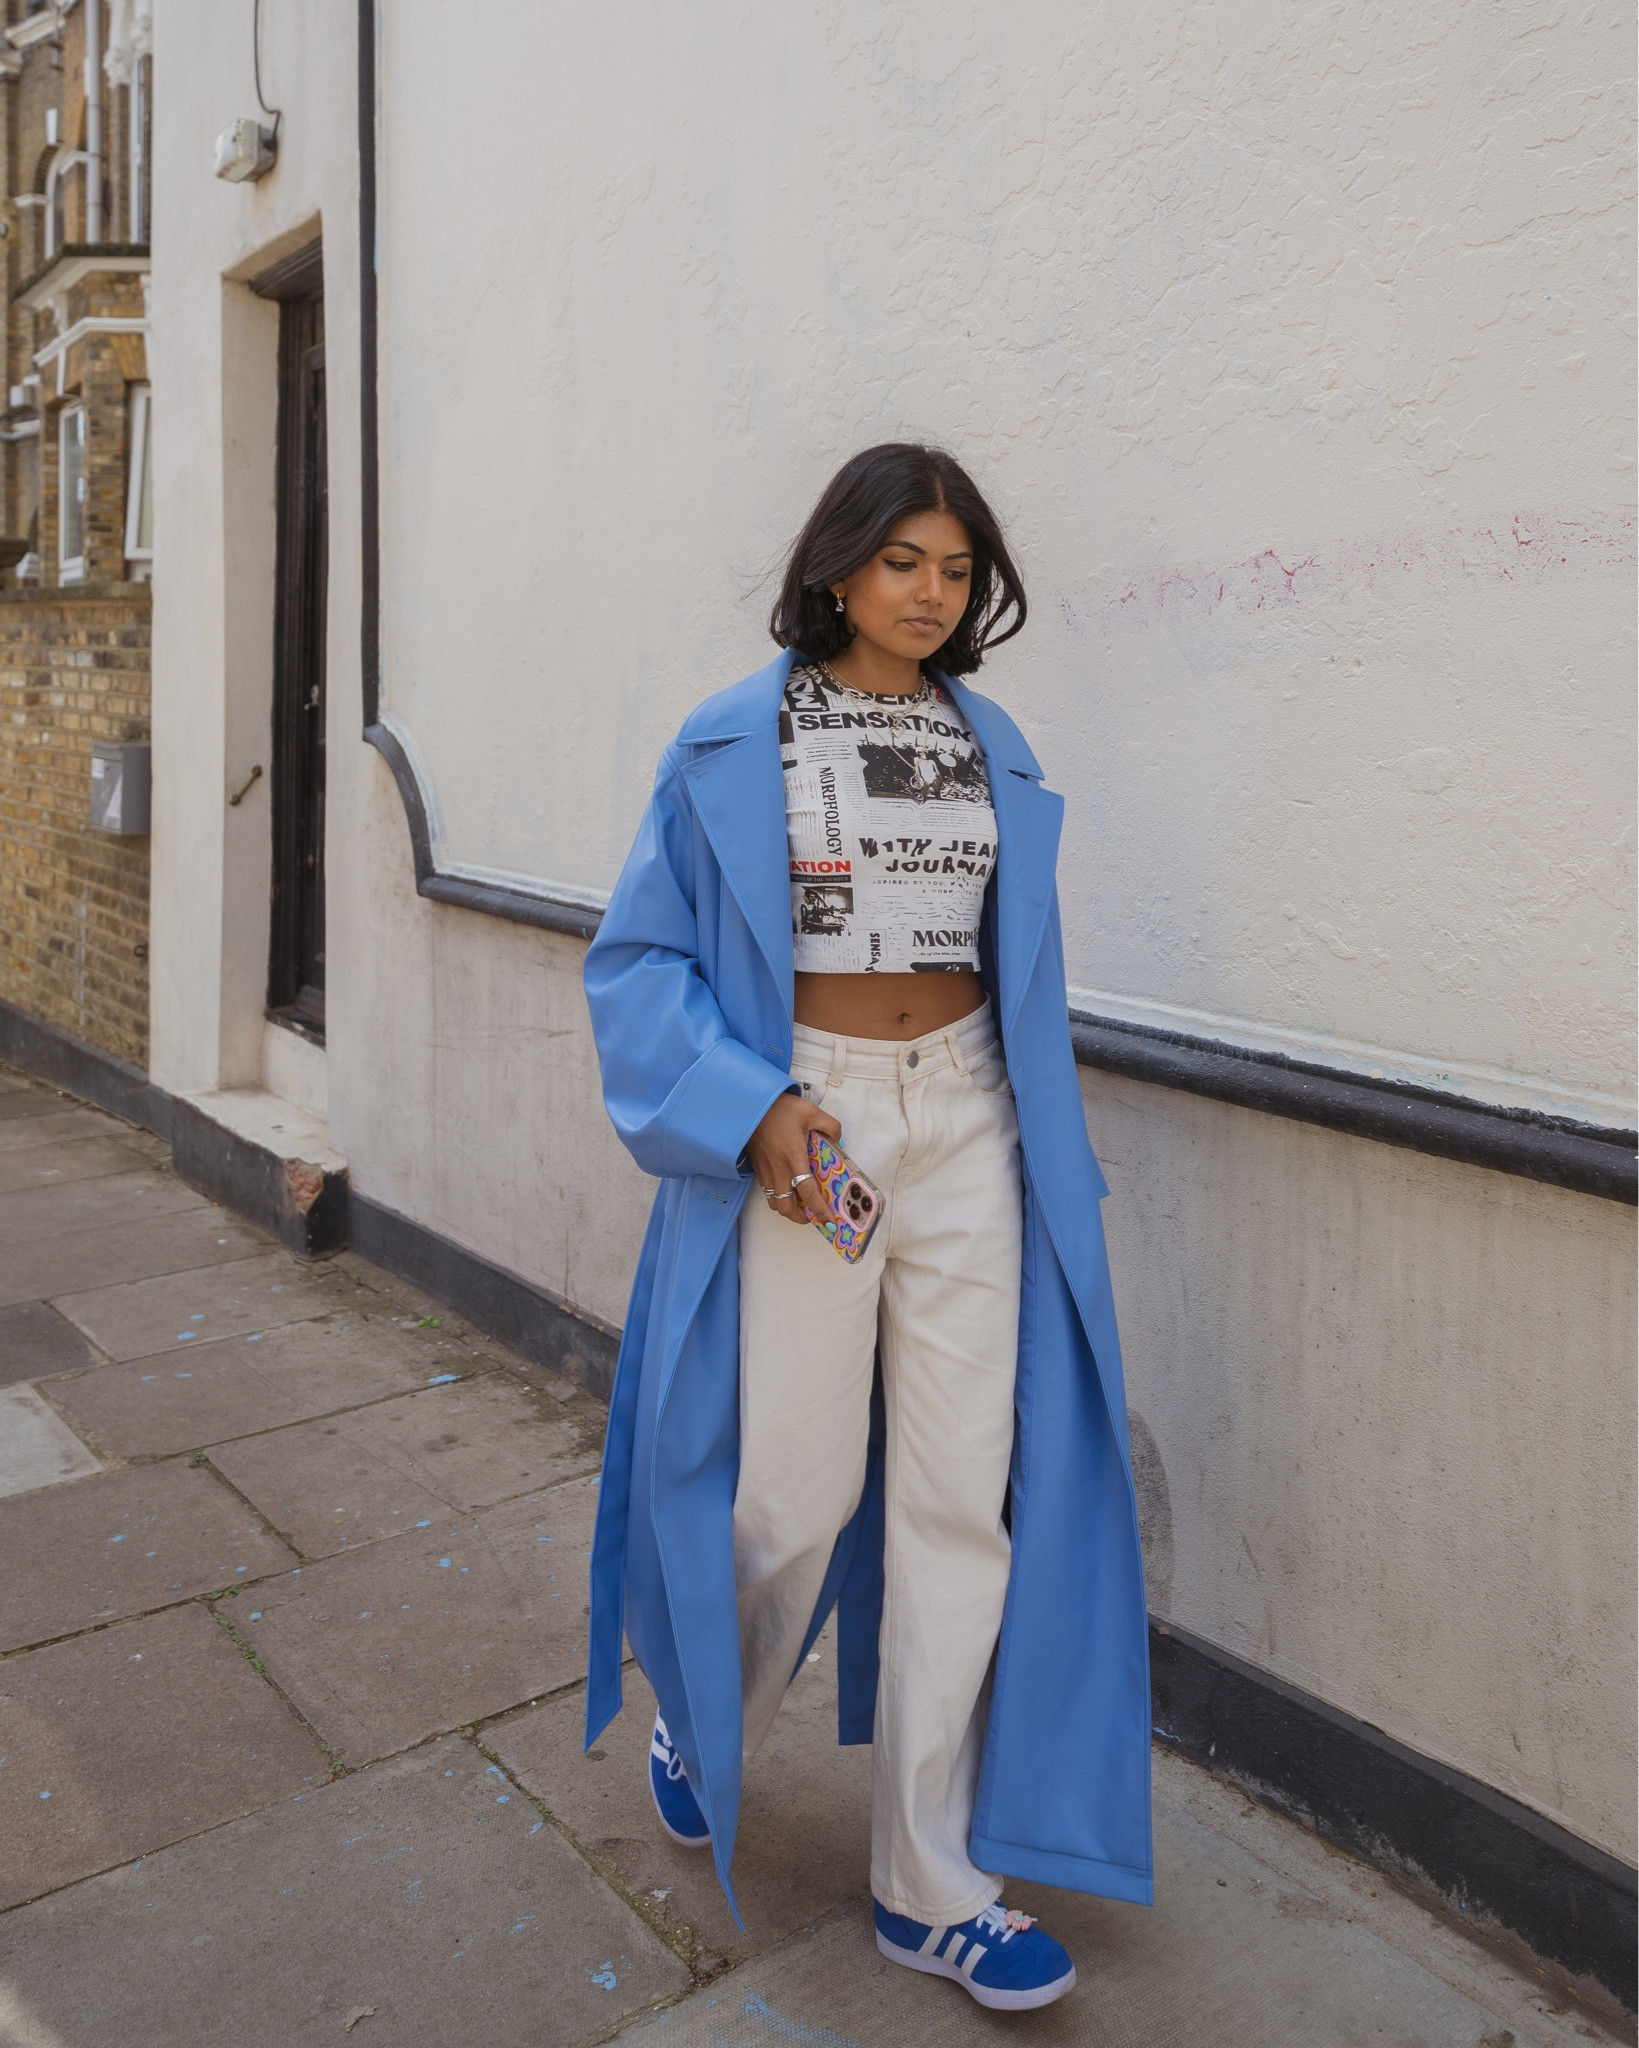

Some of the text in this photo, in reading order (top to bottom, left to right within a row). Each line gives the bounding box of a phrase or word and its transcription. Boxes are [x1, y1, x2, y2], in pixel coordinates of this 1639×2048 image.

[797, 711, 972, 743] SENSATION
[819, 766, 843, 857] MORPHOLOGY
[791, 860, 851, 874] ATION
